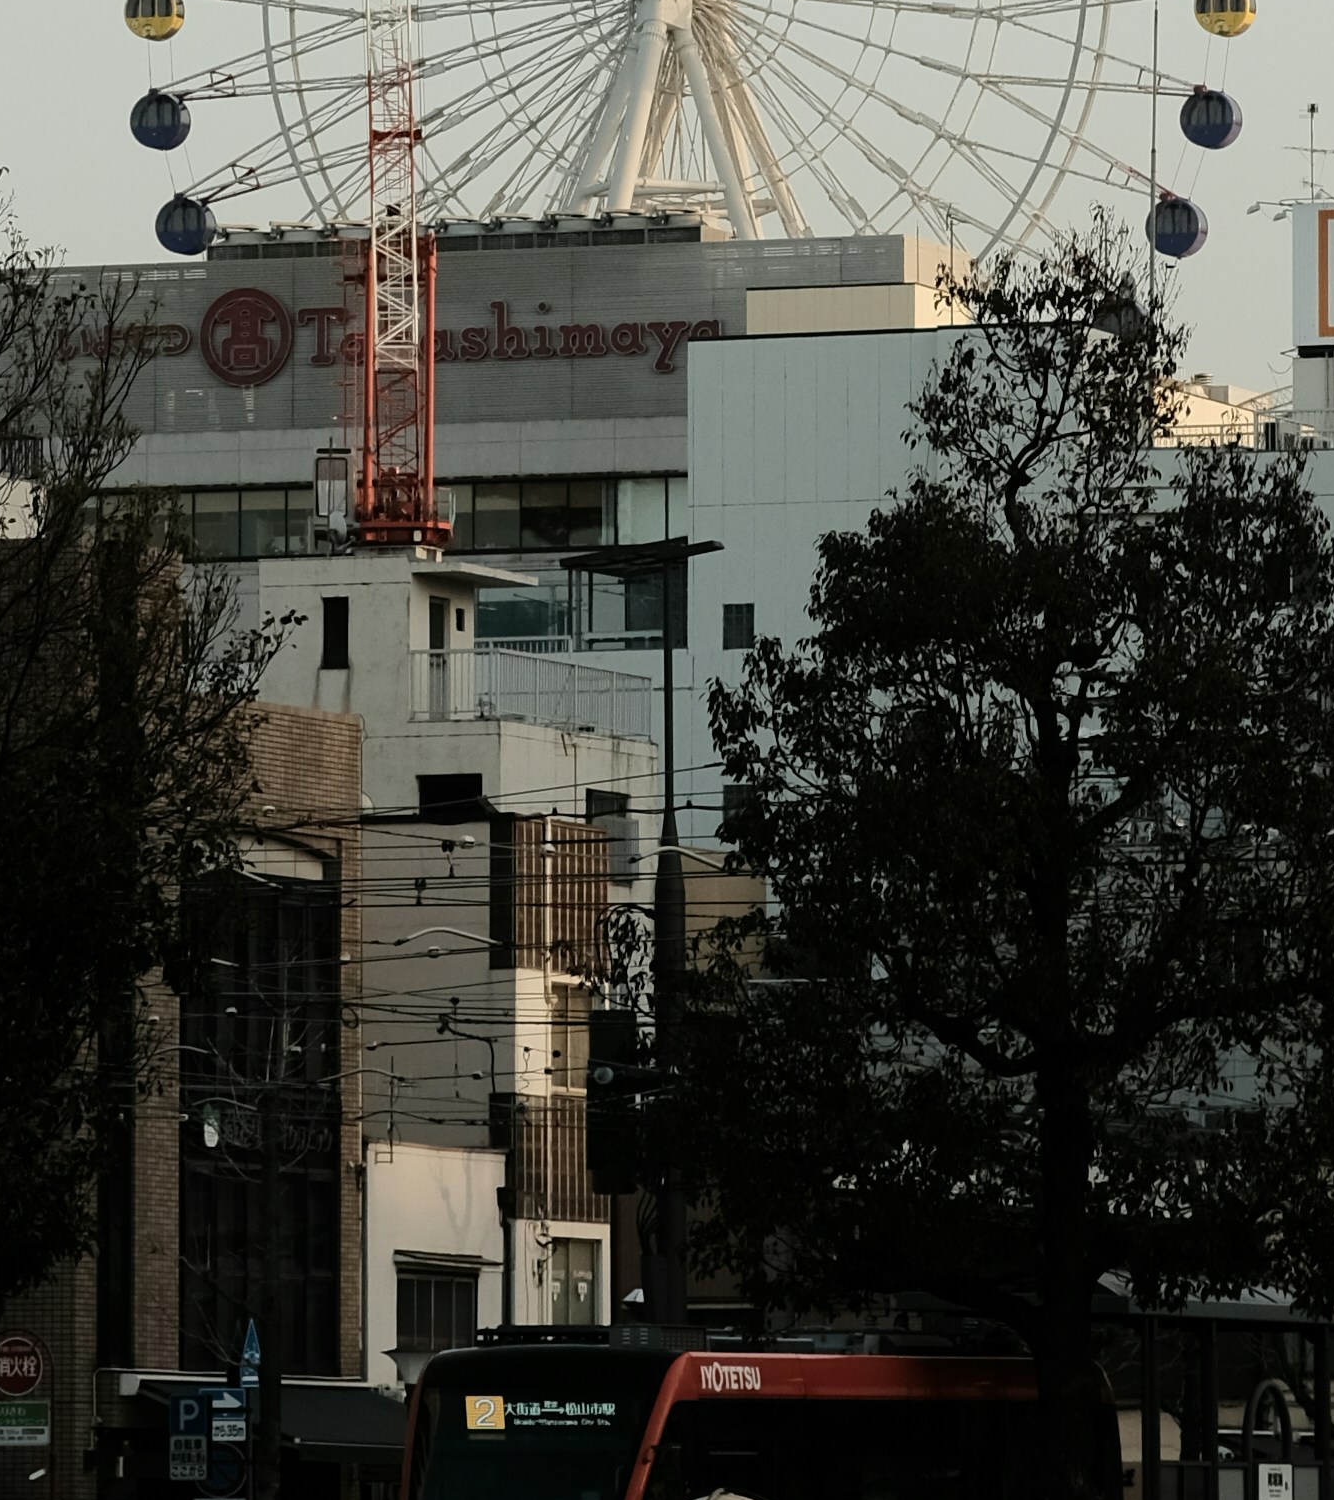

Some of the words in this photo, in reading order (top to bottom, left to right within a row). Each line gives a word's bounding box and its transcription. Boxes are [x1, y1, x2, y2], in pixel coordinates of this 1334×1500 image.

[297, 301, 722, 373] Taashimaya
[700, 1361, 761, 1392] IYOTETSU
[178, 1399, 200, 1432] P
[474, 1399, 496, 1427] 2
[565, 1402, 616, 1417] 松山市駅
[171, 1465, 205, 1478] ここから
